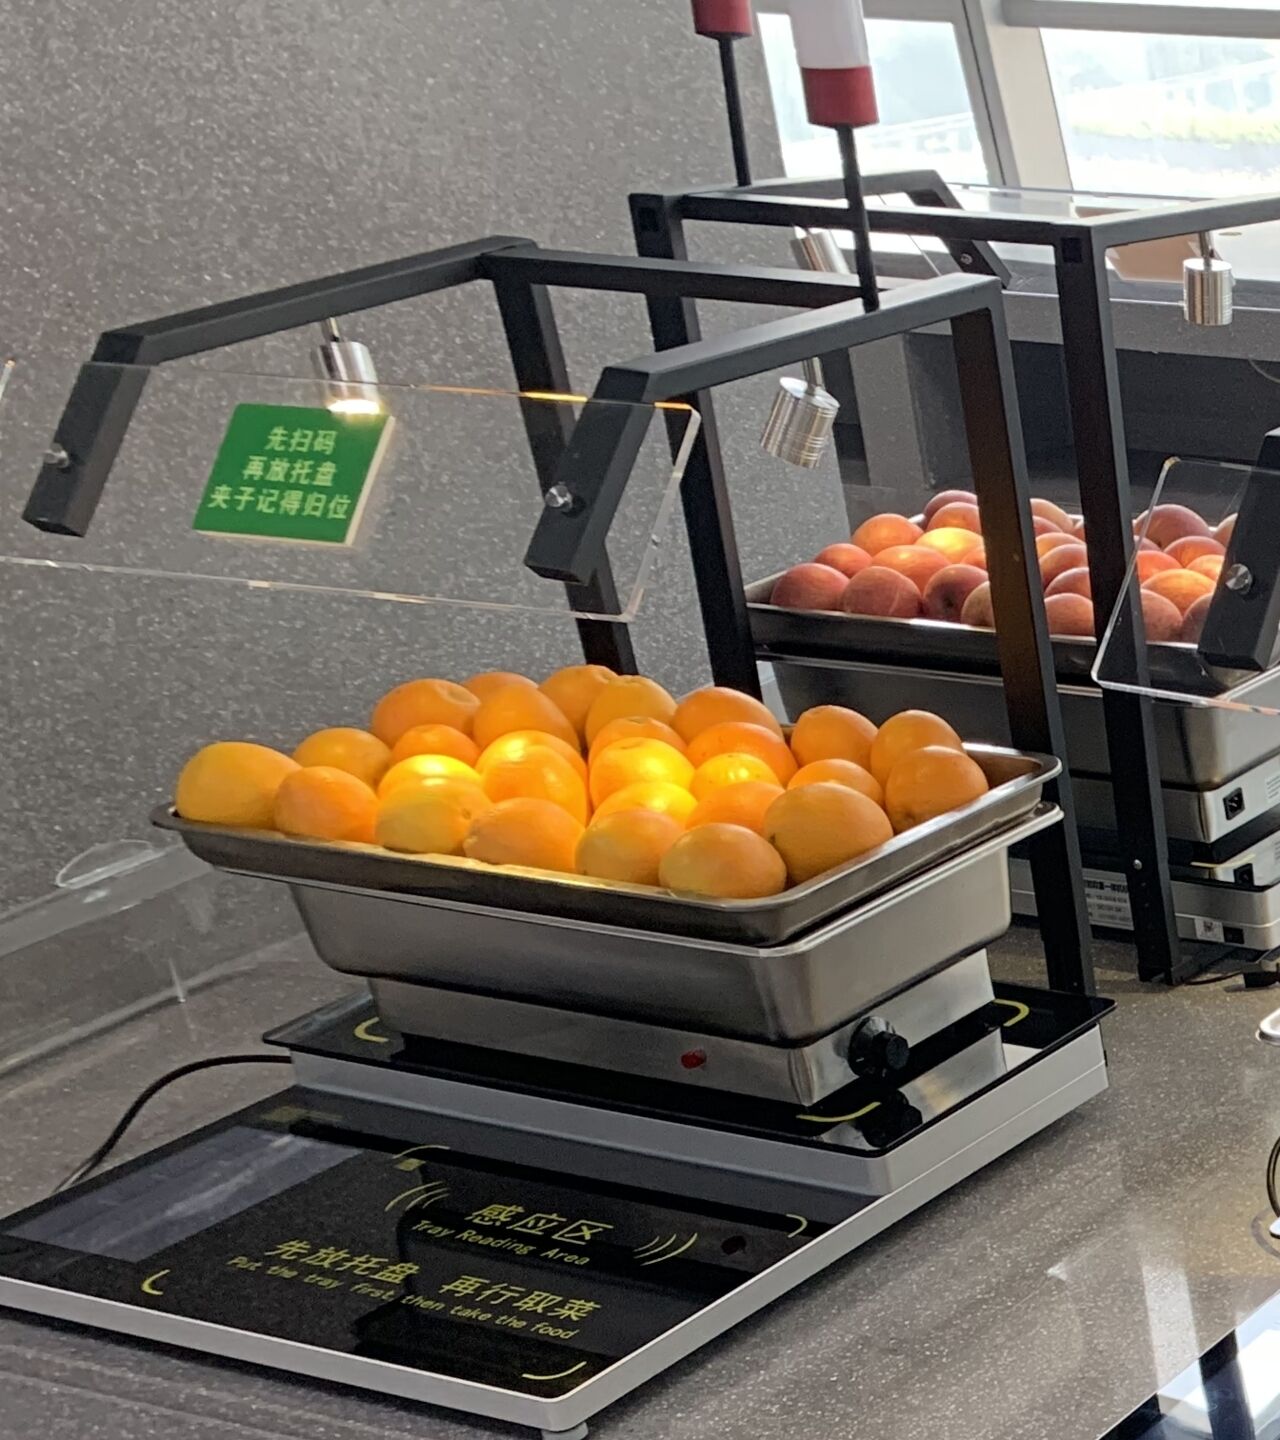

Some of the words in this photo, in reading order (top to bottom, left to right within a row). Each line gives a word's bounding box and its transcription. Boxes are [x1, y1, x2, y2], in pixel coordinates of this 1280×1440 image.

[264, 425, 338, 455] 先扫码
[242, 455, 338, 487] 再放托盘
[207, 484, 352, 519] 夹子记得归位
[411, 1219, 455, 1239] Tray
[456, 1228, 537, 1256] Reading
[540, 1245, 591, 1266] Area
[465, 1203, 614, 1245] 感应区
[226, 1255, 262, 1271] Put
[266, 1263, 299, 1279] the
[304, 1273, 343, 1290] tray
[449, 1302, 492, 1322] take
[494, 1311, 527, 1330] the
[530, 1320, 580, 1341] food
[264, 1239, 420, 1286] 先放托盘
[439, 1274, 602, 1323] 再行取菜
